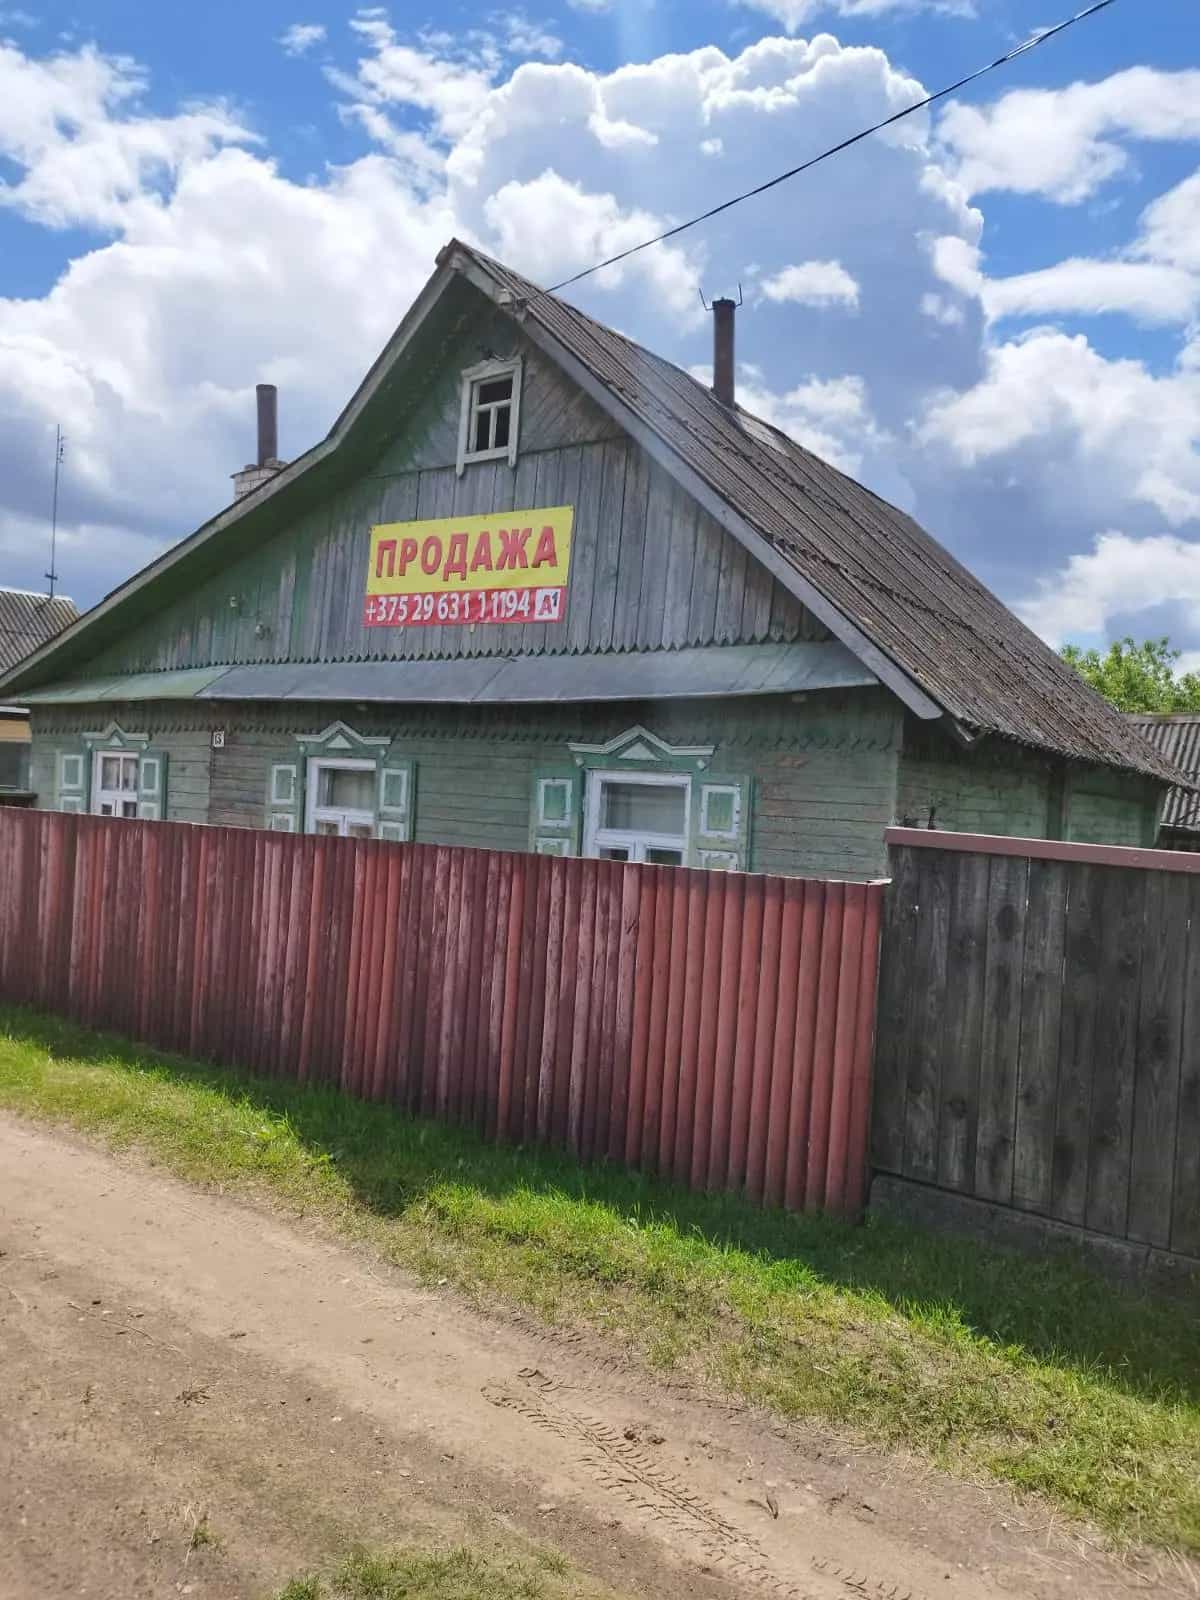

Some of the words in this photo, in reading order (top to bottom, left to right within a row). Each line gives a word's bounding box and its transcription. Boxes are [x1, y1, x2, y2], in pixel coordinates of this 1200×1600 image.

[376, 526, 558, 582] ПРОДАЖА
[366, 595, 408, 622] +375
[412, 594, 434, 621] 29
[438, 592, 471, 620] 631
